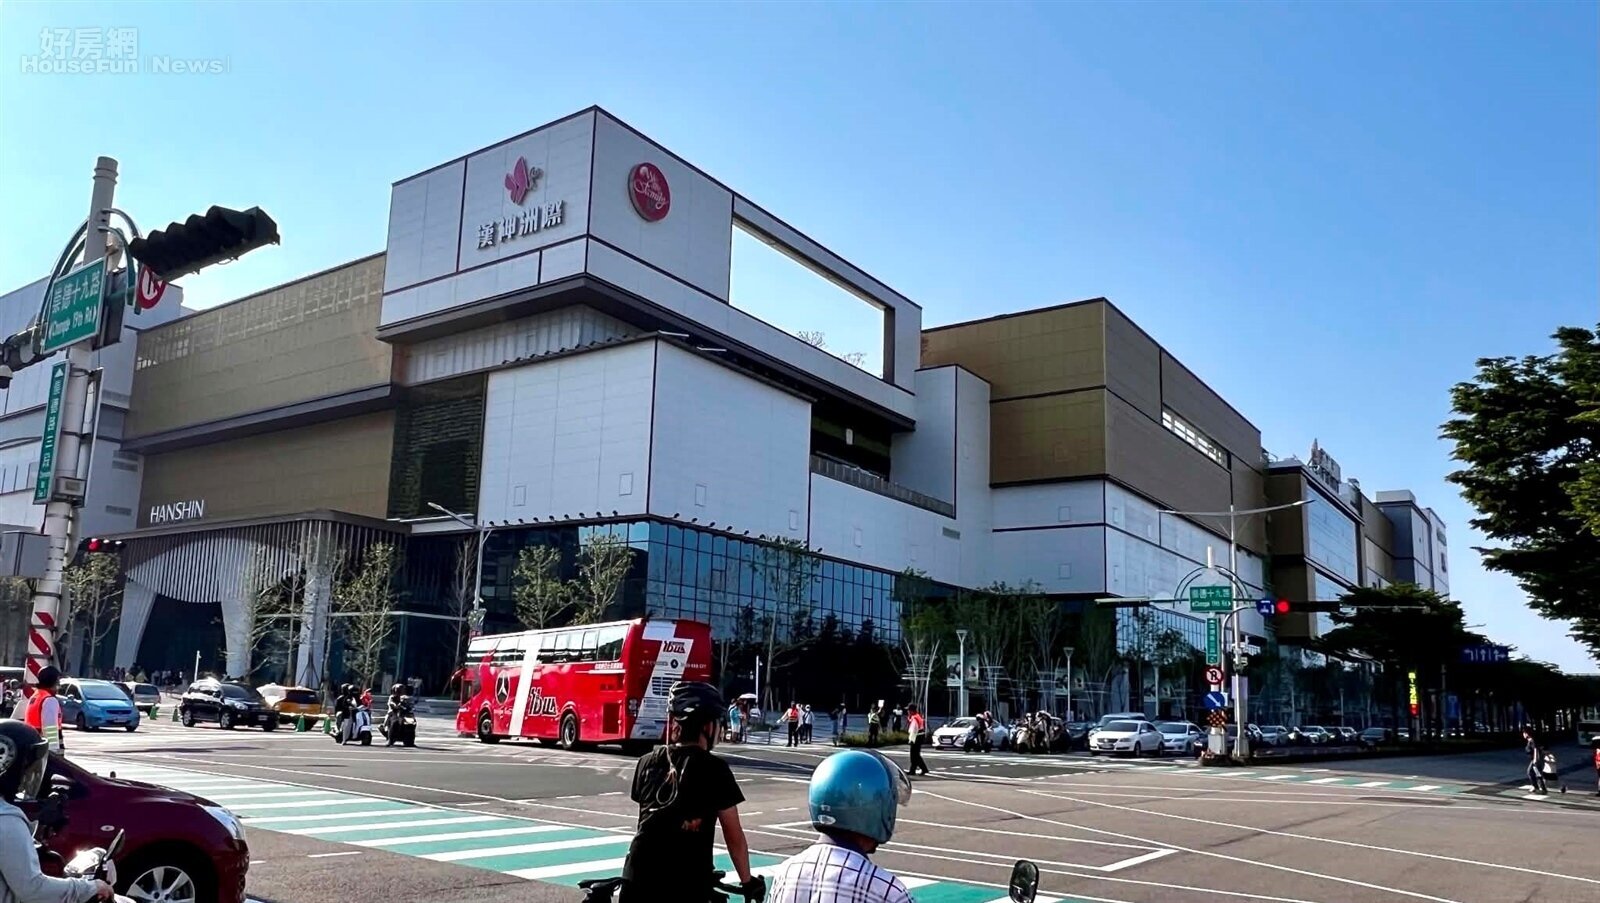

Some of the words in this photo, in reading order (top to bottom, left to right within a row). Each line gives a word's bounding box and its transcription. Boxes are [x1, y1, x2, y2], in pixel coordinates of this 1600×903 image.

[478, 200, 564, 248] 漢神洲際
[150, 499, 205, 523] HANSHIN
